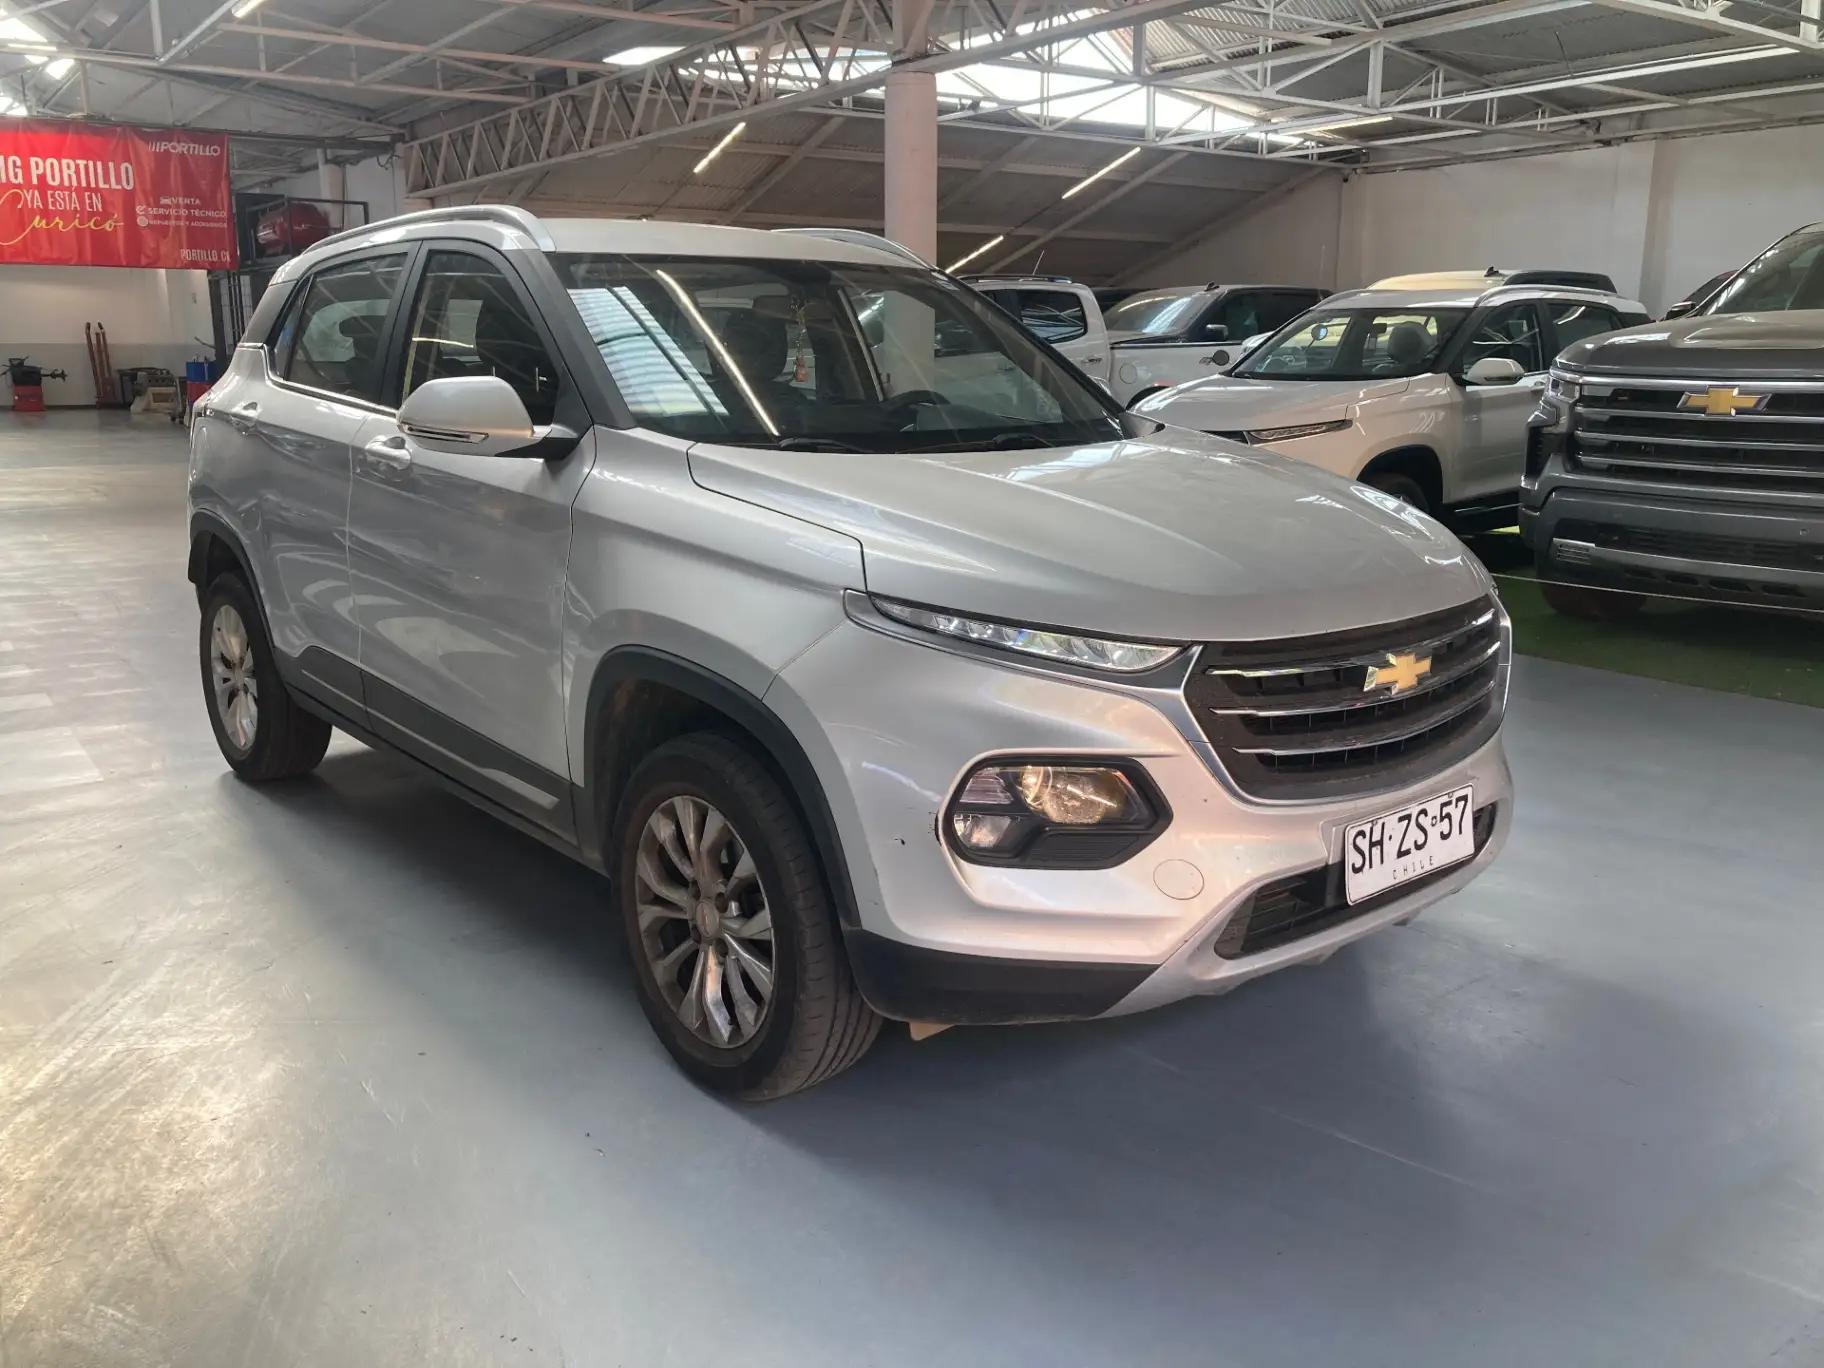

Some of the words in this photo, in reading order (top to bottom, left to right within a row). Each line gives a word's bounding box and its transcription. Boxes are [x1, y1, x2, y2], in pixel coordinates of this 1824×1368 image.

[29, 156, 135, 190] PORTILLO
[23, 189, 43, 208] YA
[47, 186, 80, 211] ESTÁ
[84, 192, 103, 212] EN
[148, 207, 188, 216] SERVICIO
[190, 209, 226, 218] TÉCNICO
[1392, 855, 1434, 880] CHILE
